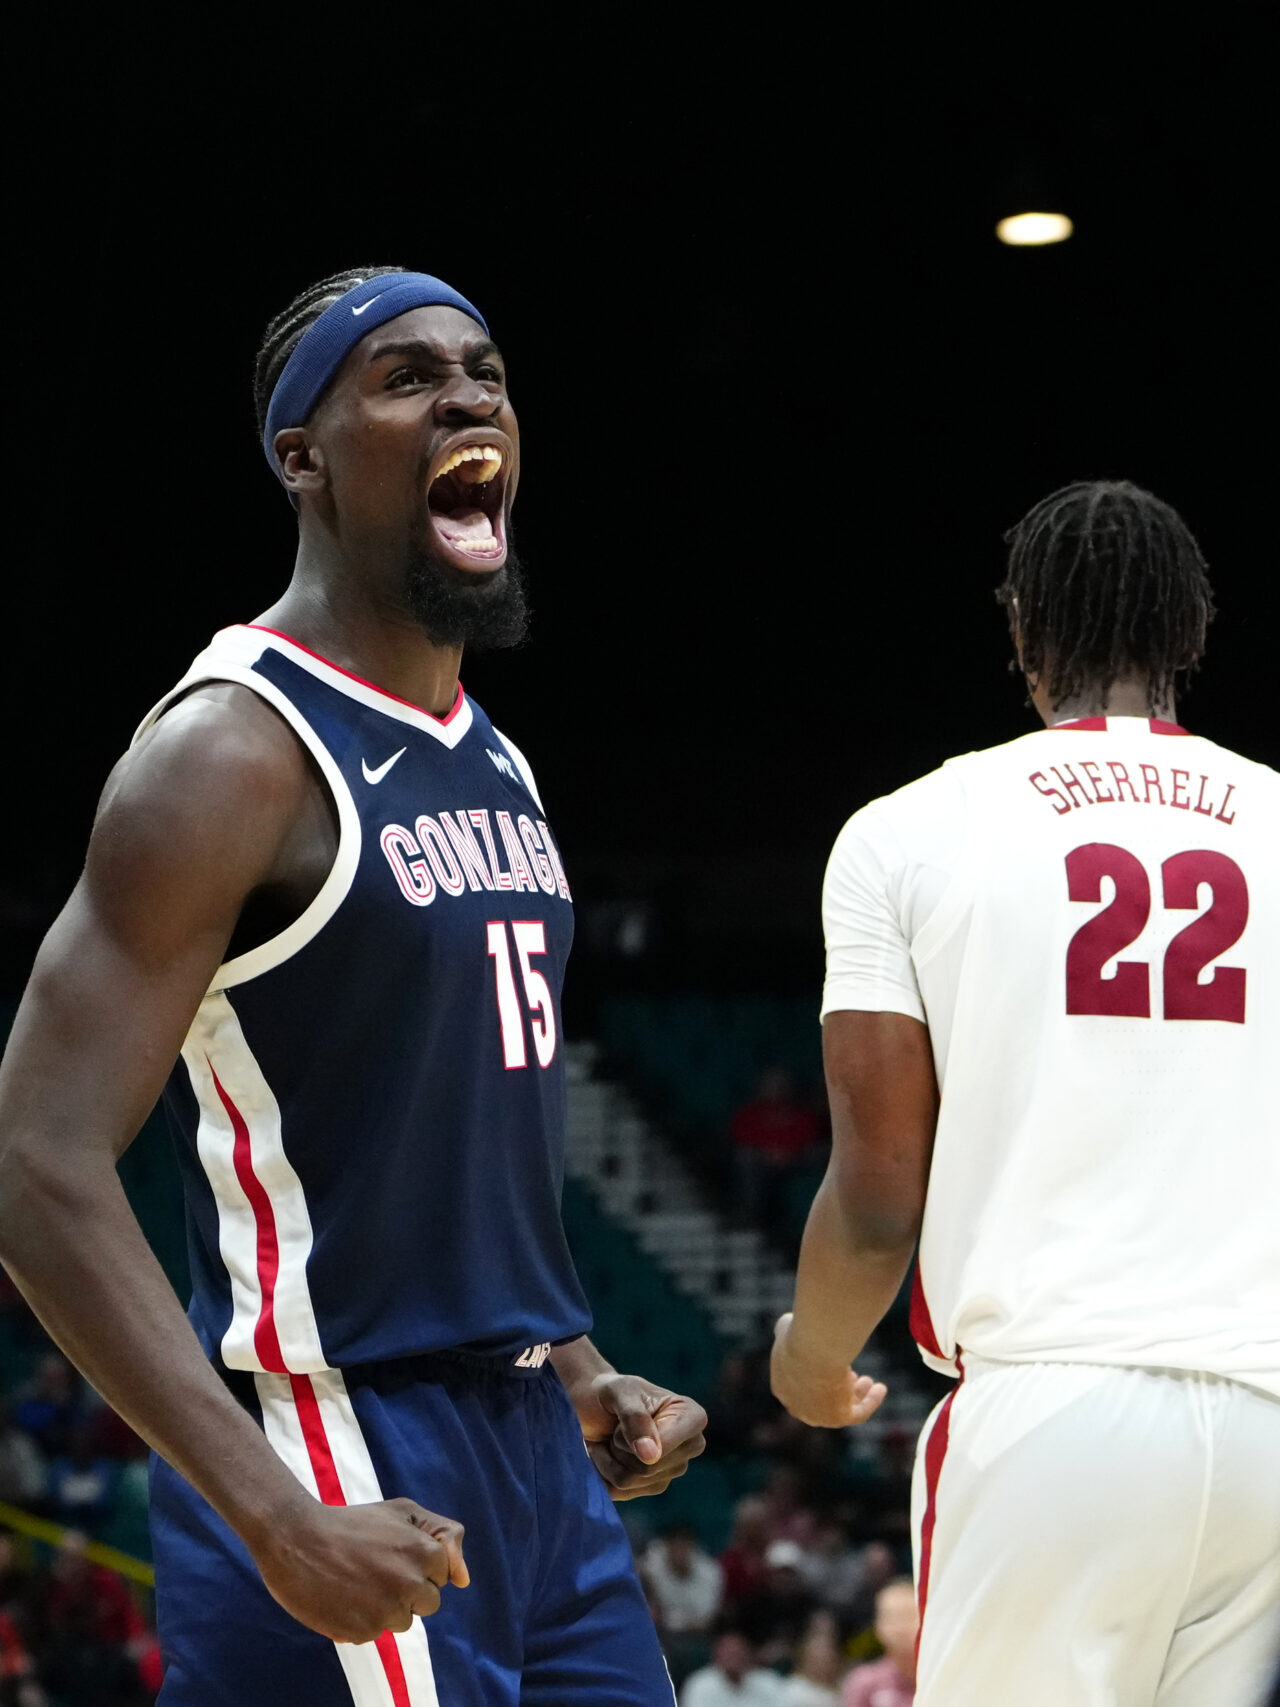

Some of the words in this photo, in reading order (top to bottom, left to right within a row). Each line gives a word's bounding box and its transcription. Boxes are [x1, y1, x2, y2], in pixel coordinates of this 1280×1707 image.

[1028, 761, 1236, 826] SHERRELL
[486, 920, 557, 1071] 15
[1064, 842, 1250, 1025] 22
